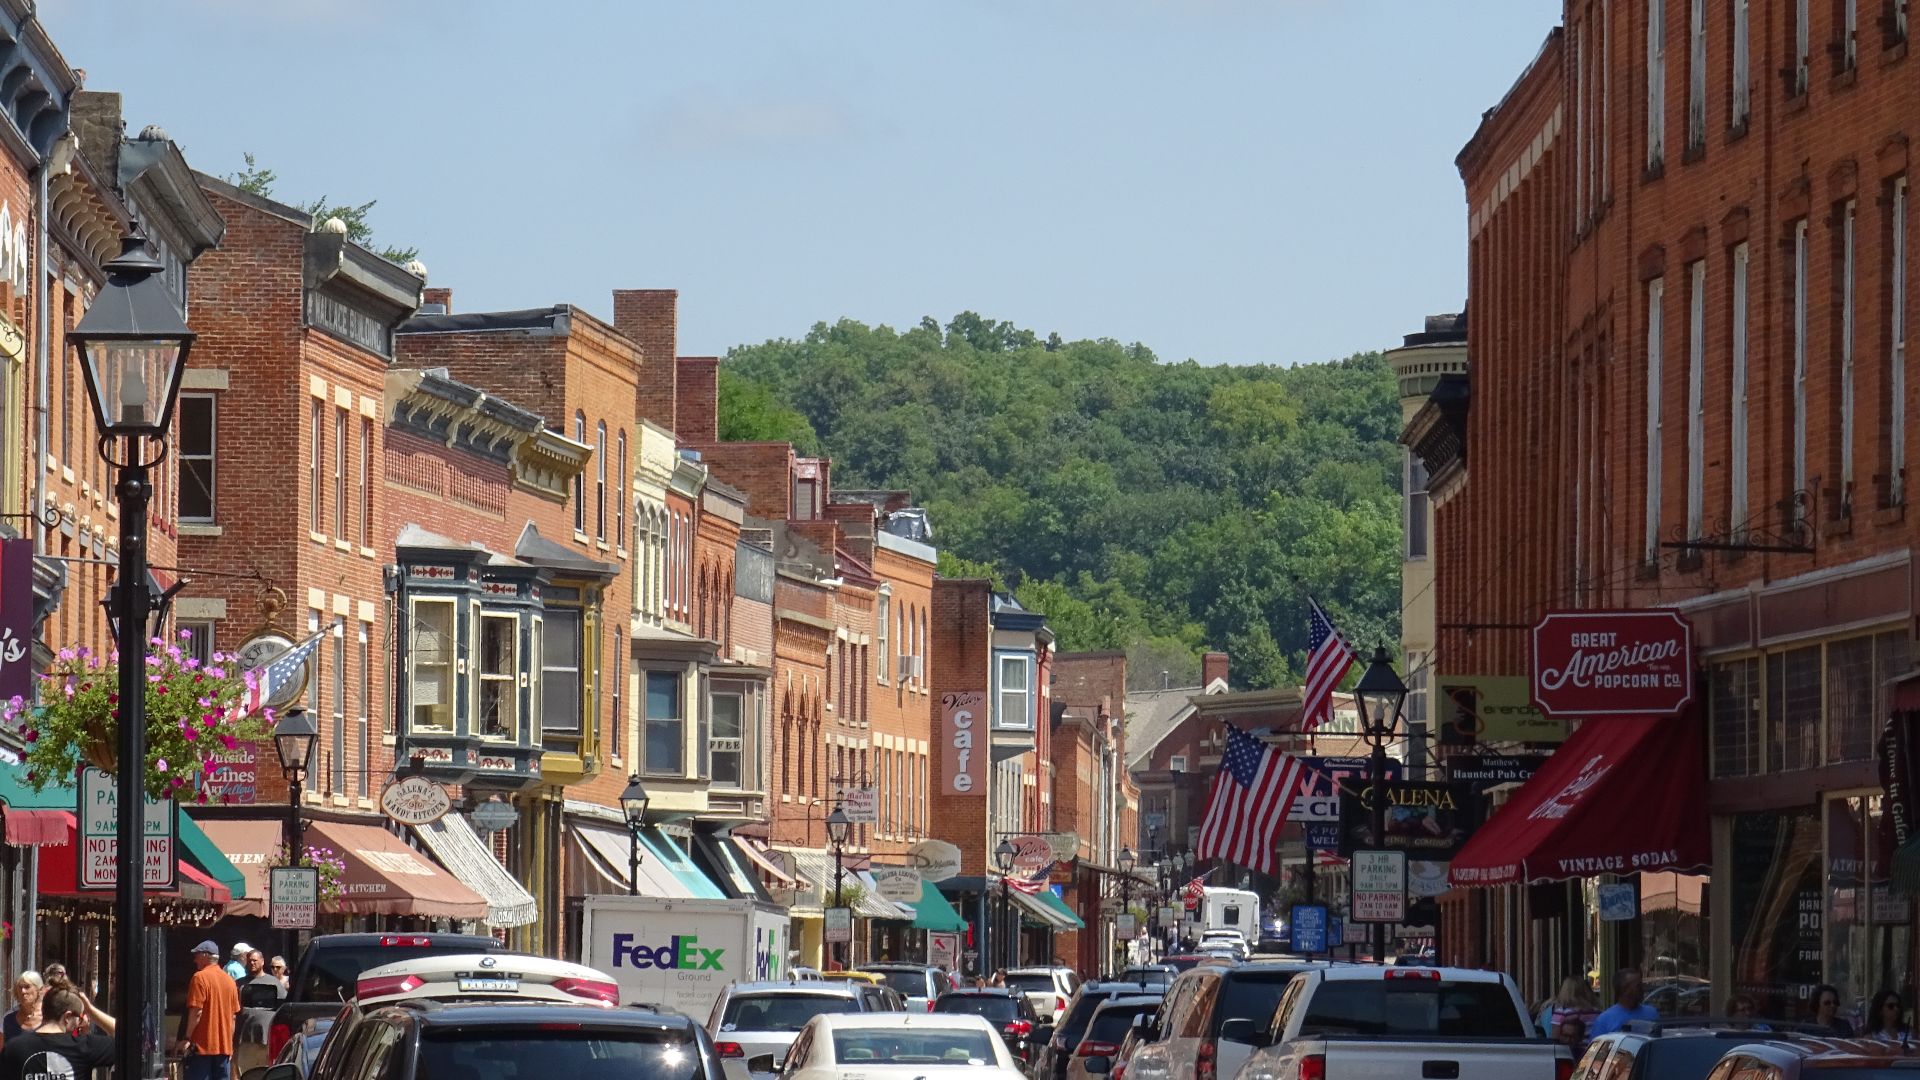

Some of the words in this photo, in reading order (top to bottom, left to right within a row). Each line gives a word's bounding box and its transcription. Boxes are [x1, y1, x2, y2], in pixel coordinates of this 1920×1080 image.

[1571, 632, 1617, 648] GREAT
[1541, 639, 1682, 690] American
[1595, 674, 1659, 688] POPCORN
[953, 710, 973, 793] cafe
[1885, 735, 1897, 778] Home
[1482, 759, 1520, 767] Matthew's
[1453, 769, 1494, 779] Haunted
[1497, 769, 1516, 779] Pub
[397, 785, 435, 800] GALENA'S
[1889, 783, 1901, 798] in
[385, 799, 409, 819] KANDY
[413, 800, 446, 819] KITCHEN
[143, 820, 160, 832] PM
[90, 839, 106, 852] NO
[110, 839, 166, 853] PING
[145, 855, 161, 867] AM
[1558, 855, 1624, 873] VINTAGE
[1632, 848, 1678, 867] SODAS
[144, 869, 161, 880] FRI
[1361, 864, 1397, 874] PARKING
[279, 880, 310, 889] PARKING
[349, 883, 386, 893] KITCHEN
[1356, 892, 1367, 902] NO
[1369, 892, 1401, 902] PARKING
[613, 933, 725, 971] FedEx
[677, 971, 712, 982] Ground
